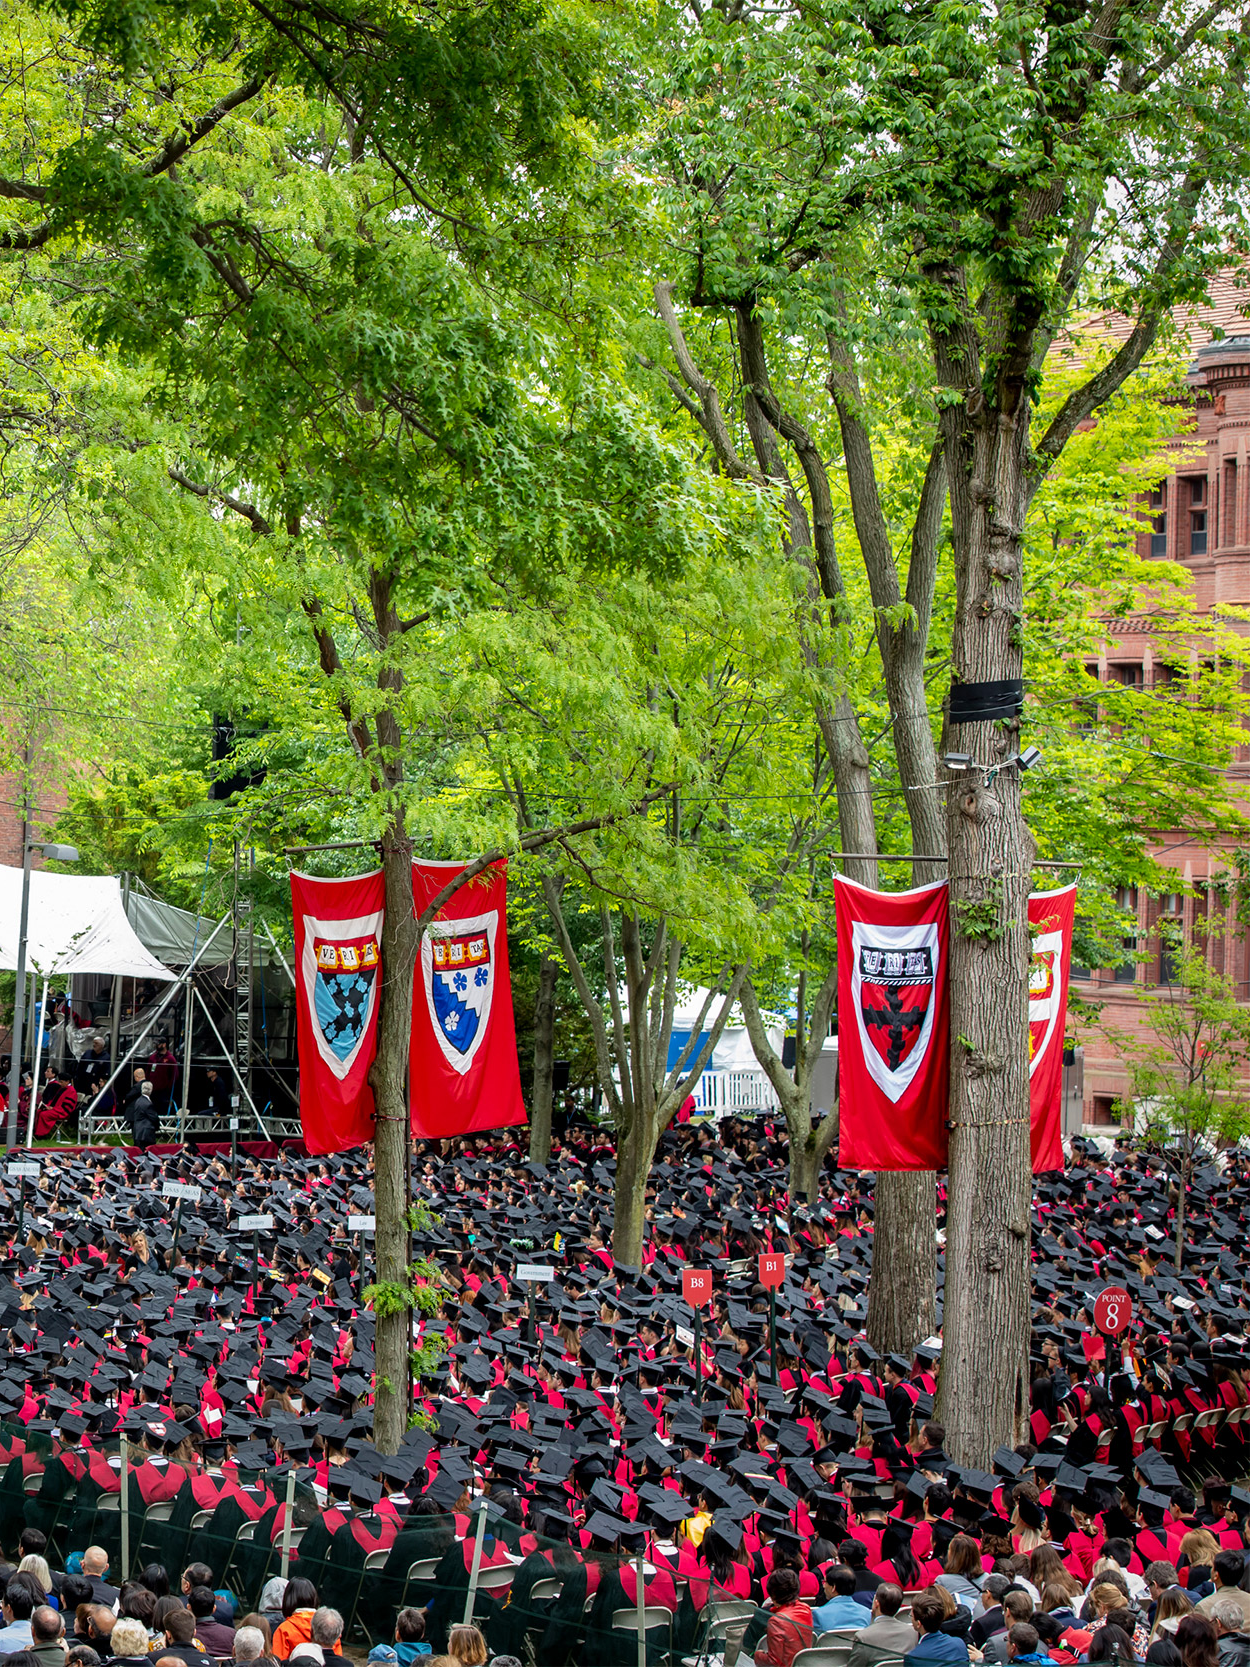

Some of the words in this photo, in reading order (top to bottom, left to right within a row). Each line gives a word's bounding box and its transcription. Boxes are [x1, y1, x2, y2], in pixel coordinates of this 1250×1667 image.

[766, 1261, 777, 1271] B1
[521, 1269, 550, 1277] Government
[690, 1277, 704, 1288] B8
[1101, 1294, 1127, 1303] POINT
[1105, 1303, 1119, 1330] 8
